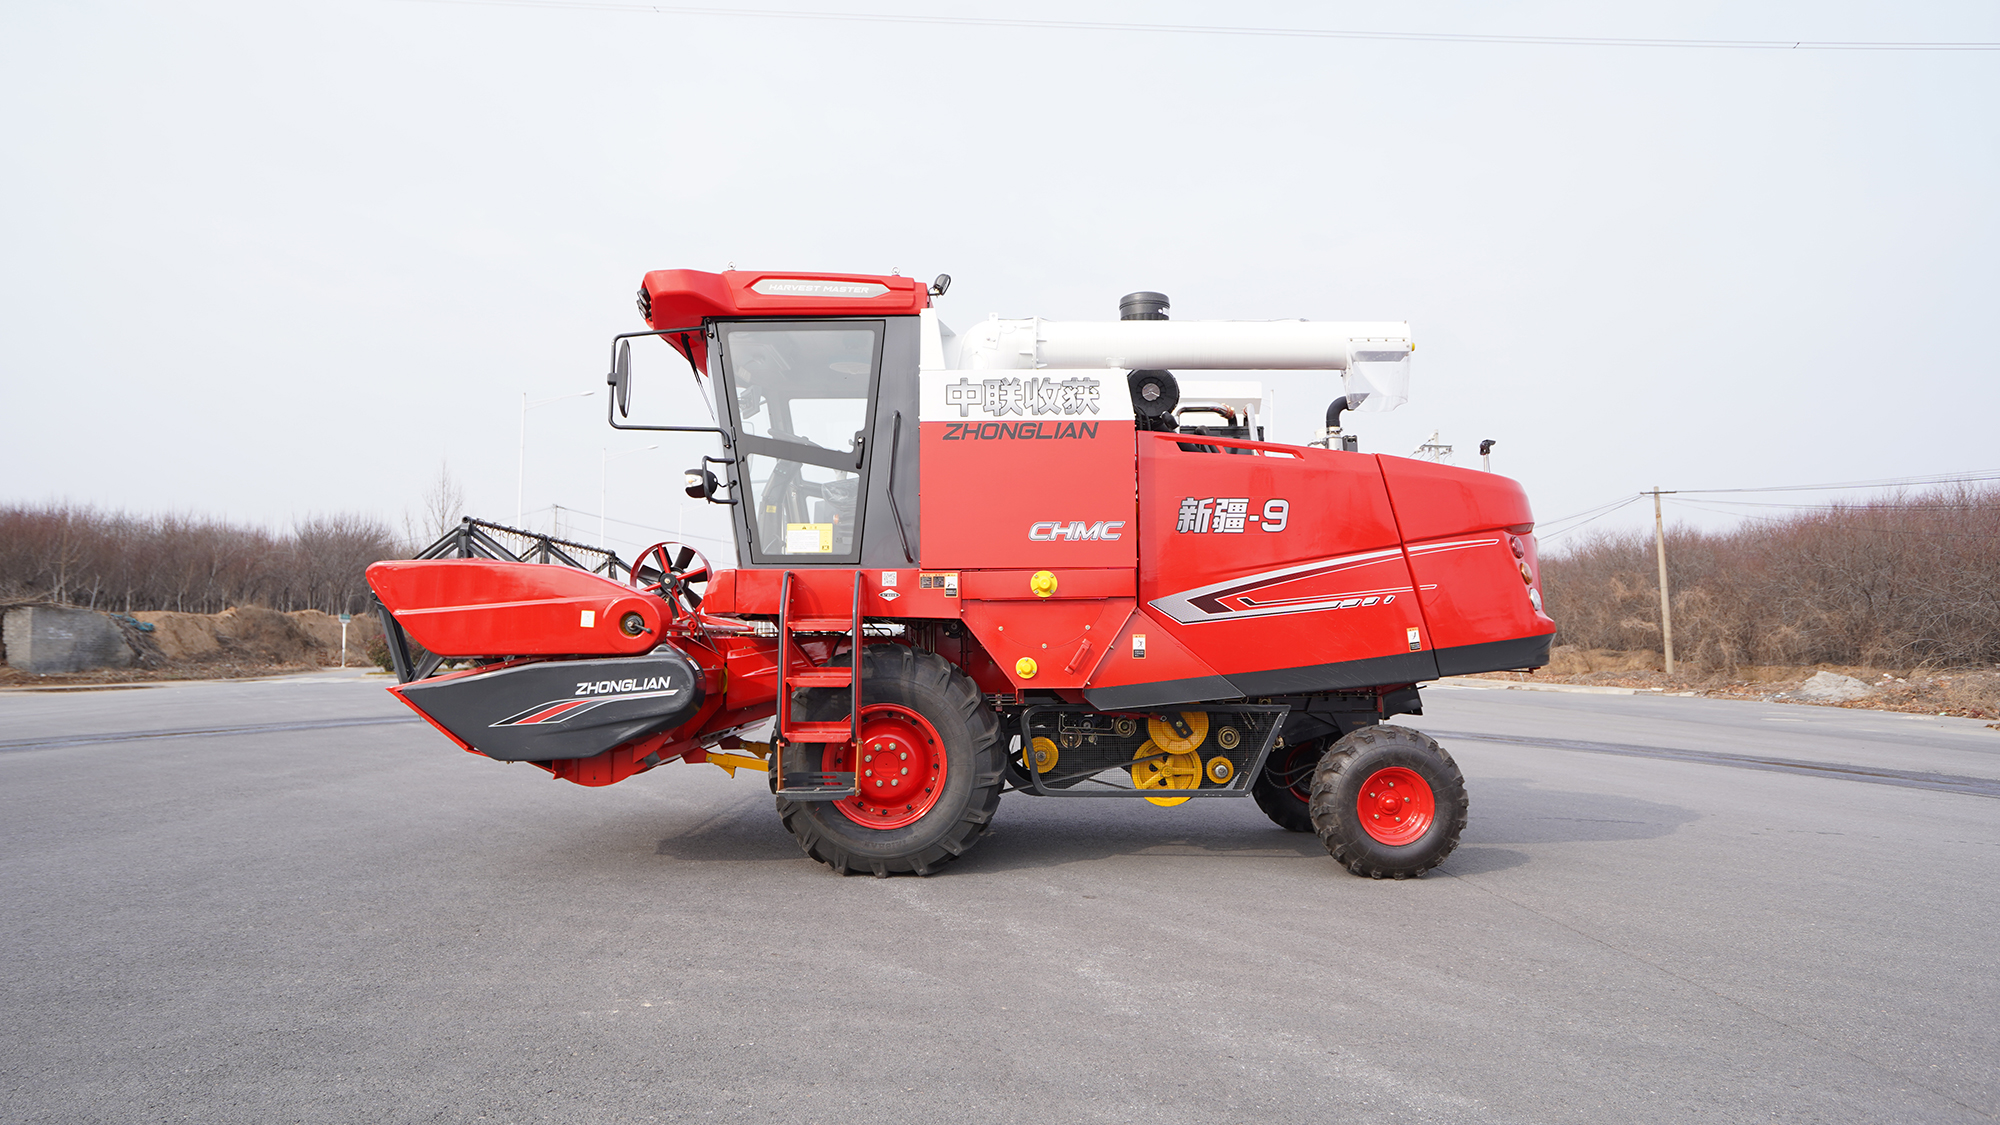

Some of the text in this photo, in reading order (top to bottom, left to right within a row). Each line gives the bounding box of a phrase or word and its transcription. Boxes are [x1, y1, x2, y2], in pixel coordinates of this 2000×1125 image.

[768, 284, 869, 293] HARVEST MASTER
[946, 377, 1100, 417] 中联收获
[942, 422, 1099, 440] ZHONGLIAN
[1176, 497, 1289, 533] 新疆-9
[1028, 521, 1125, 541] CHMC
[575, 676, 670, 695] ZHONGLIAN
